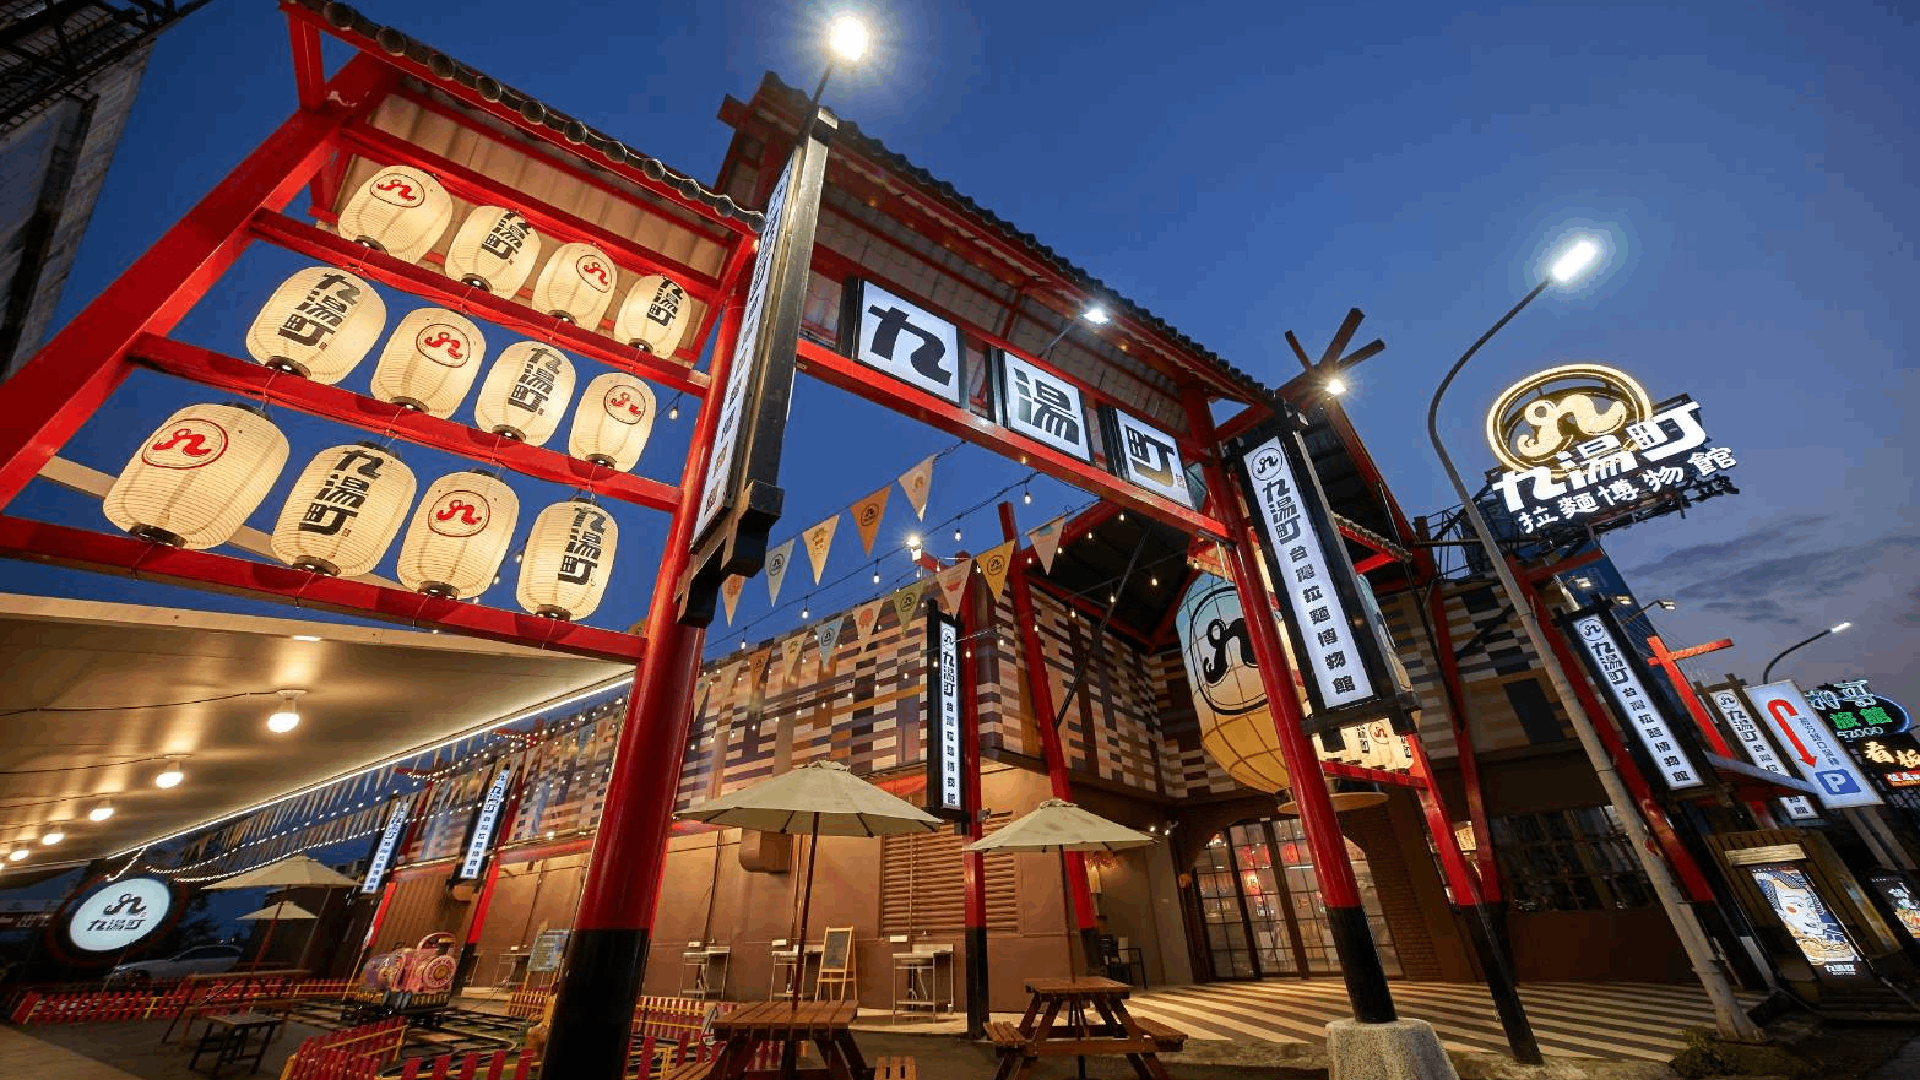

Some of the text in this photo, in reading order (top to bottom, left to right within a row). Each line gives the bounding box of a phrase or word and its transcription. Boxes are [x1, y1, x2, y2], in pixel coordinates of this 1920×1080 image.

[1518, 447, 1737, 534] 拉麵博物館
[1822, 773, 1846, 793] P
